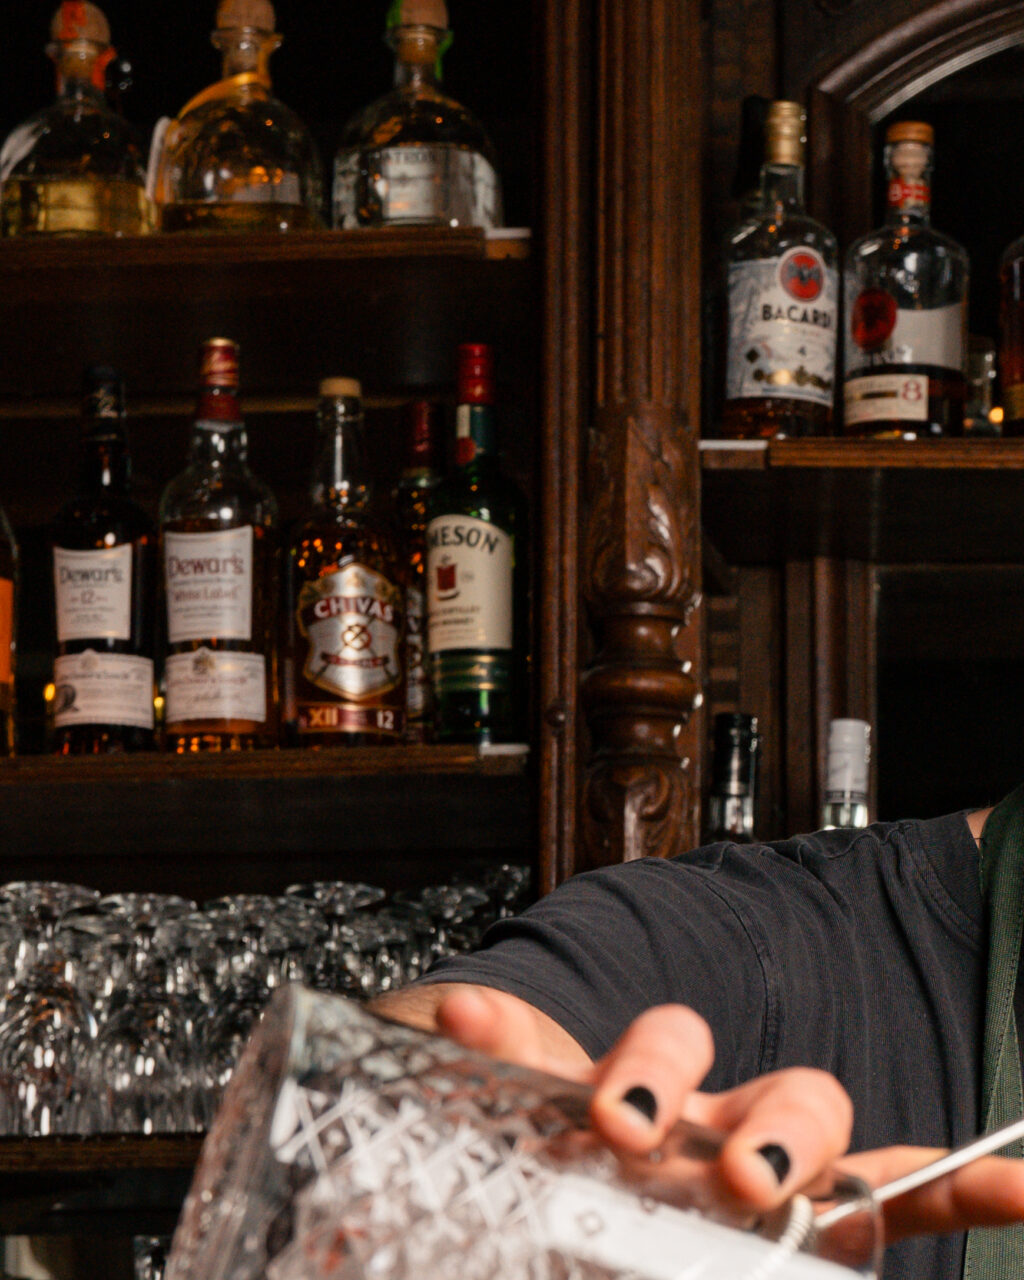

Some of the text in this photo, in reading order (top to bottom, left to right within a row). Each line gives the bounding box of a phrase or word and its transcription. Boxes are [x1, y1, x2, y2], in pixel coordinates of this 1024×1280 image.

[762, 304, 831, 328] BACARD
[902, 380, 922, 400] 8
[314, 598, 394, 622] CHIVAS
[376, 710, 394, 729] 12
